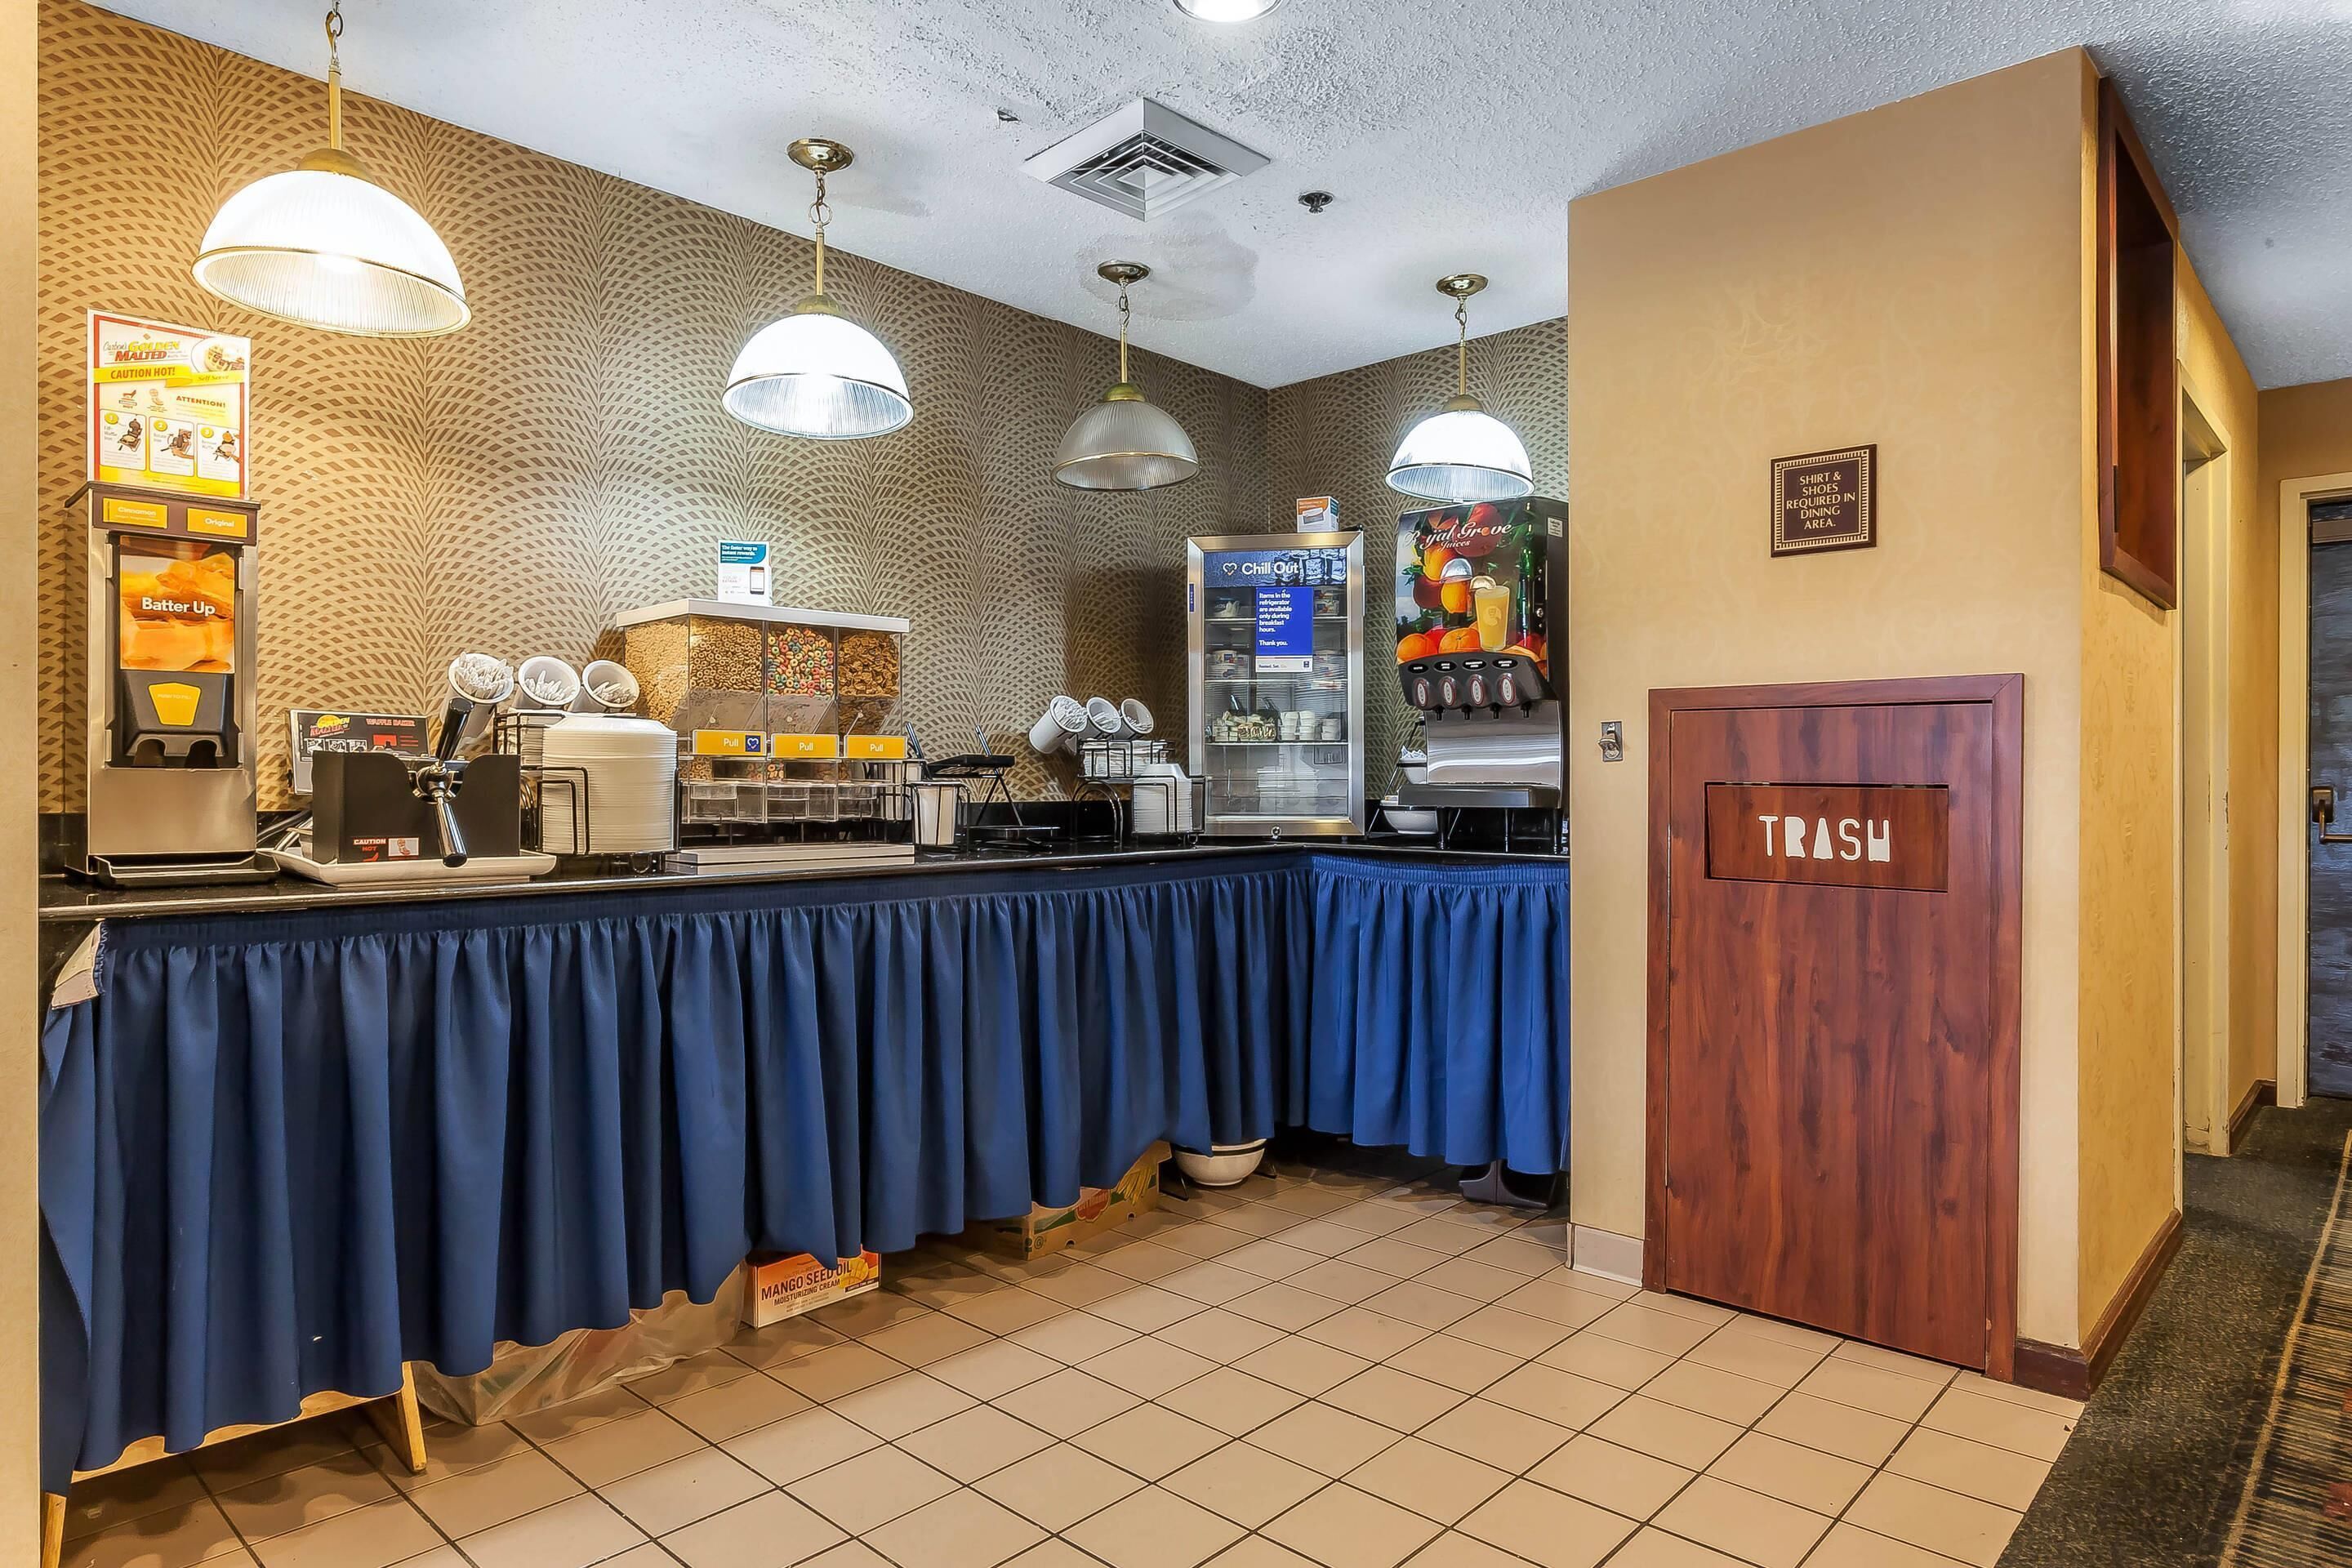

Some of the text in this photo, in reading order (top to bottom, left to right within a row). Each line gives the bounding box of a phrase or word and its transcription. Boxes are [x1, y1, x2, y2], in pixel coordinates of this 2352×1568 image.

[115, 350, 167, 361] MALTED
[111, 367, 176, 379] CAUTION HOT!
[176, 395, 226, 408] ATTENTION!
[1799, 471, 1842, 485] SHIRT &
[1802, 483, 1838, 497] SHOES
[1786, 492, 1855, 510] REQUIRED IN
[1800, 506, 1841, 519] DINING
[204, 518, 234, 528] Original
[1803, 518, 1837, 530] AREA.
[1437, 540, 1471, 552] Juices
[1241, 561, 1299, 575] Chill Out
[142, 597, 216, 617] Batter Up
[724, 738, 739, 747] Pull
[799, 742, 813, 751] Pull
[870, 744, 884, 752] Pull
[1758, 815, 1891, 862] TRASH
[761, 1276, 803, 1300] MANGO
[806, 1267, 834, 1285] SEED
[836, 1262, 852, 1277] OIL
[773, 1286, 817, 1307] MOISTURIZING
[819, 1279, 840, 1292] CREAM
